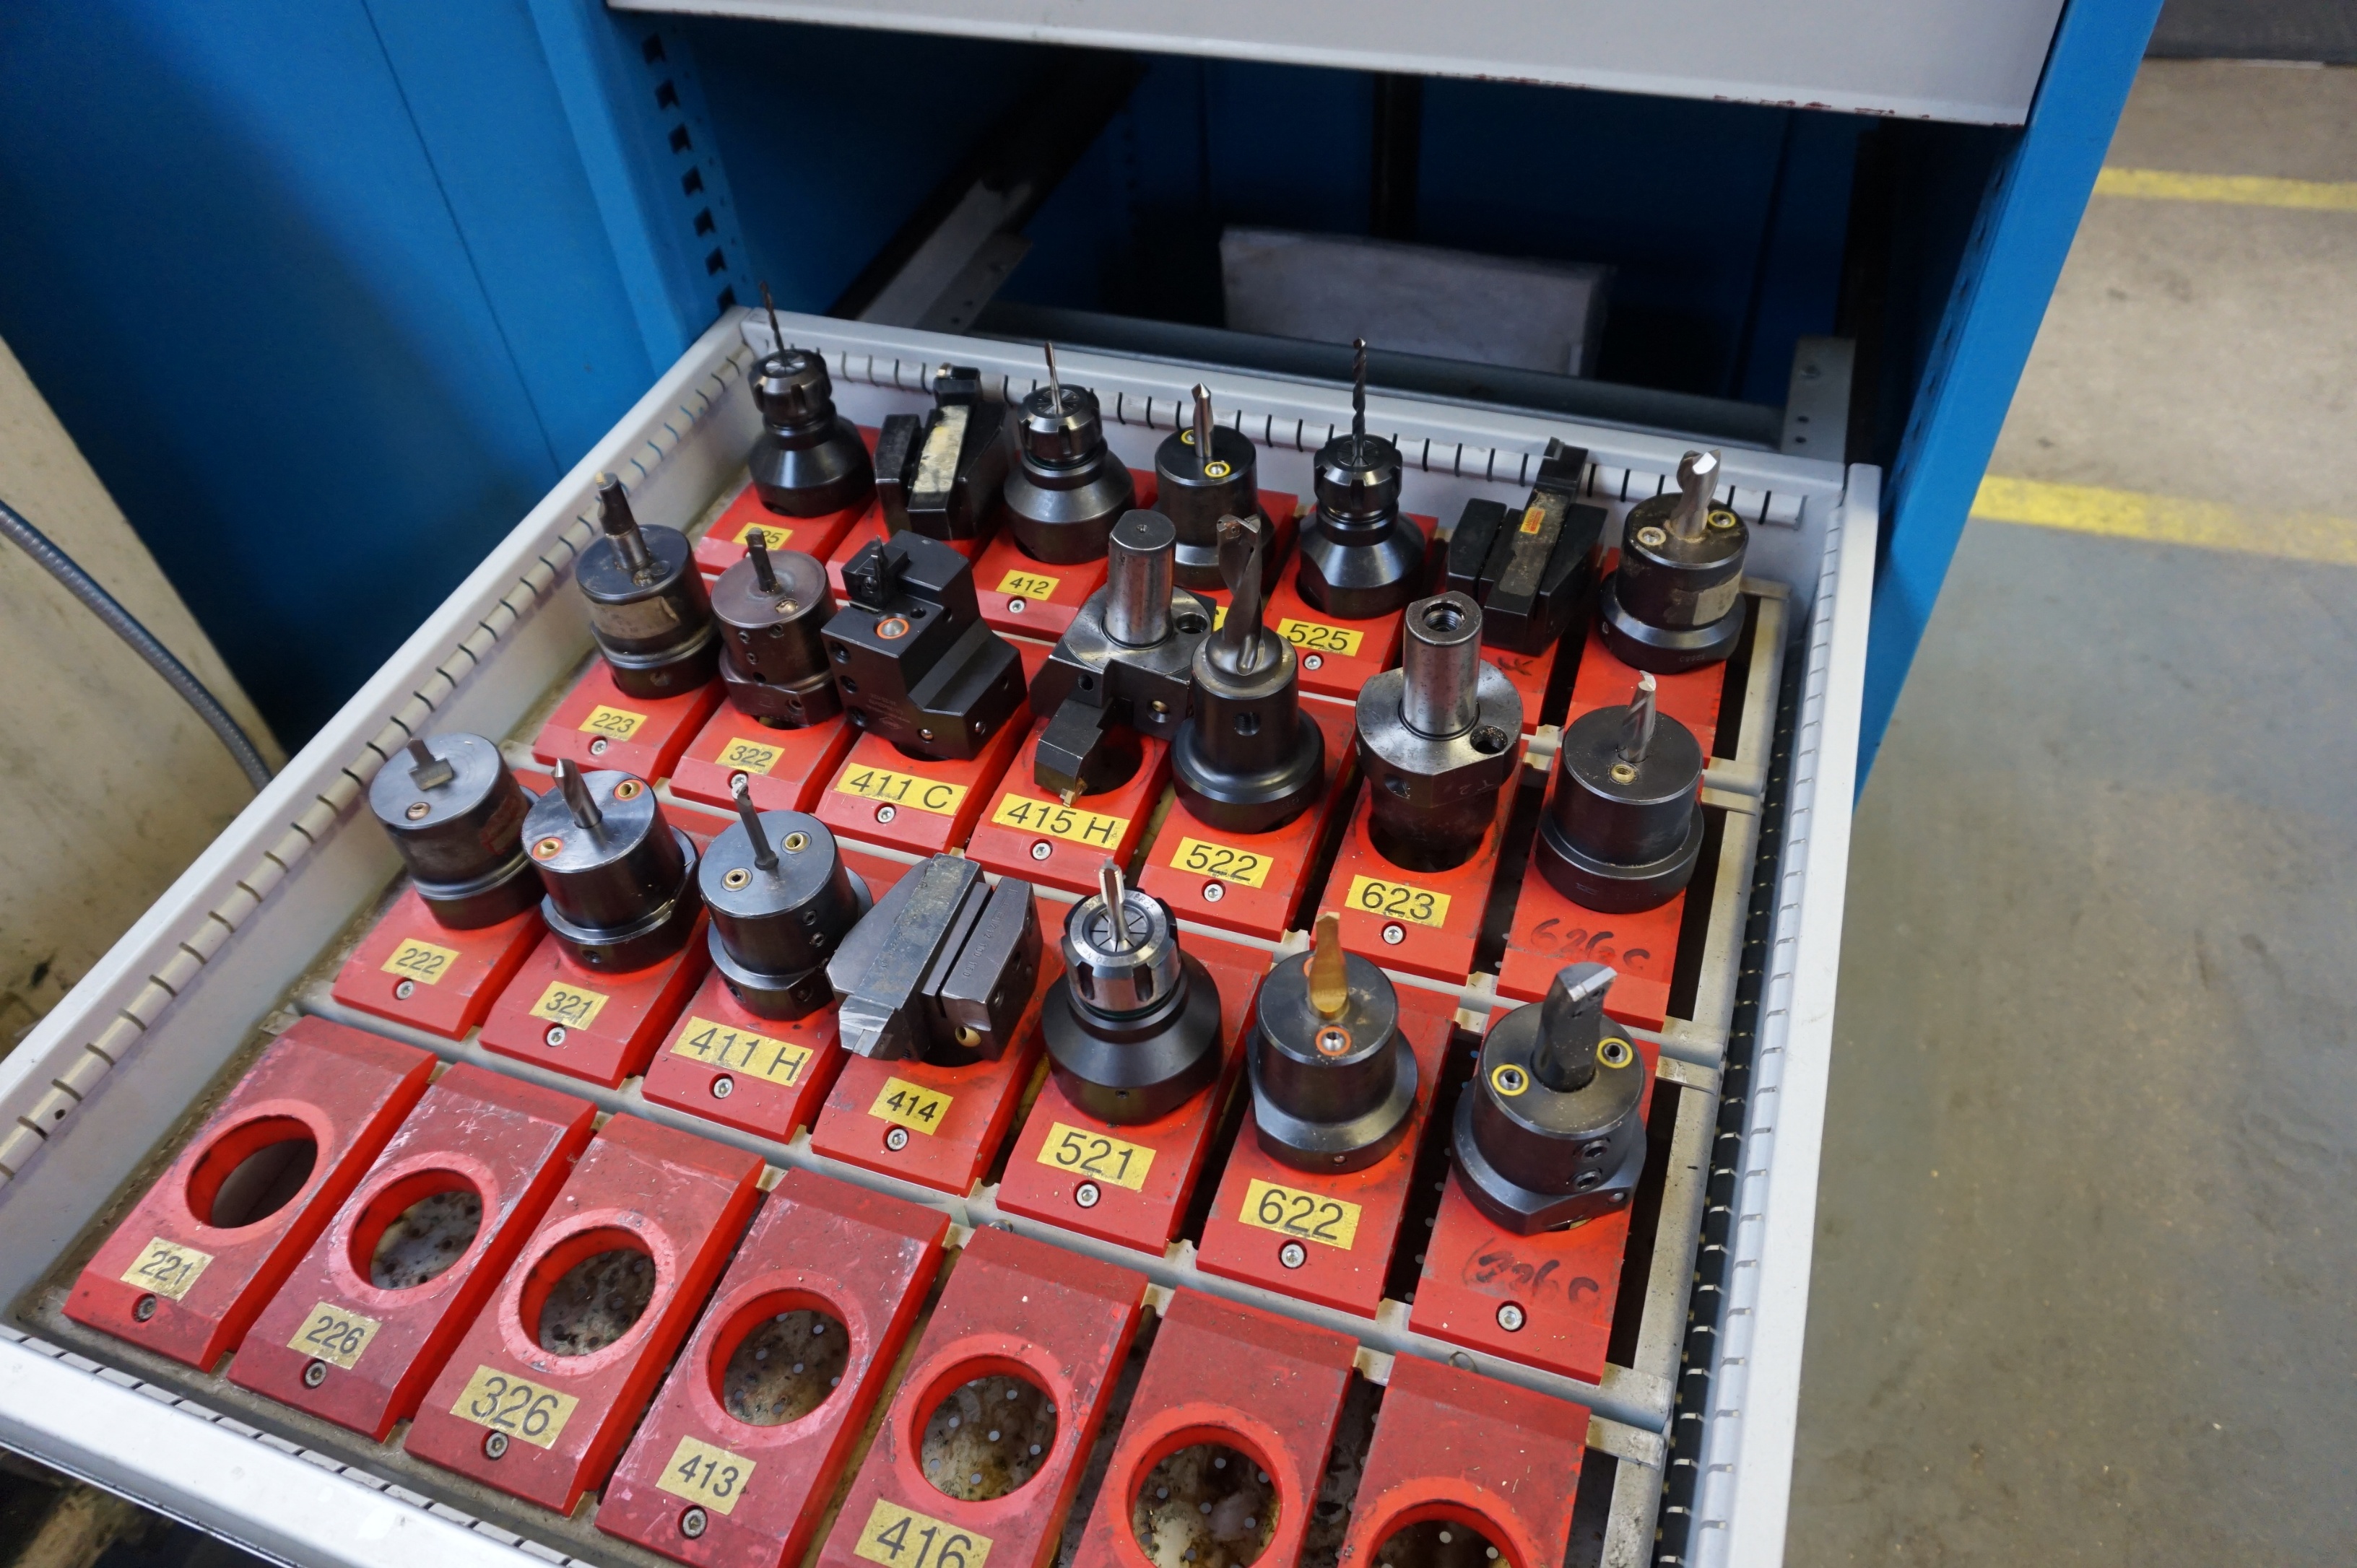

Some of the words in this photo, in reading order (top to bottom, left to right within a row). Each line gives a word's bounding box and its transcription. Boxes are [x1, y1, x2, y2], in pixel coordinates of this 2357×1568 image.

[1009, 578, 1049, 594] 412
[1287, 623, 1350, 651] 525
[591, 713, 635, 733] 223
[729, 745, 773, 768] 322
[851, 772, 913, 801] 411
[923, 785, 953, 809] C
[1007, 802, 1077, 834] 415
[1082, 816, 1116, 844] H
[1186, 844, 1258, 881] 522
[1361, 882, 1435, 920] 623
[395, 947, 445, 975] 222
[545, 991, 594, 1021] 321
[688, 1027, 760, 1068] 411
[767, 1046, 806, 1081] H
[886, 1090, 939, 1123] 414
[1056, 1131, 1134, 1180] 521
[1258, 1188, 1343, 1240] 622
[138, 1250, 194, 1286] 221
[305, 1315, 365, 1356] 226
[471, 1376, 559, 1437] 326
[677, 1455, 739, 1498] 413
[876, 1516, 973, 1568] 416
